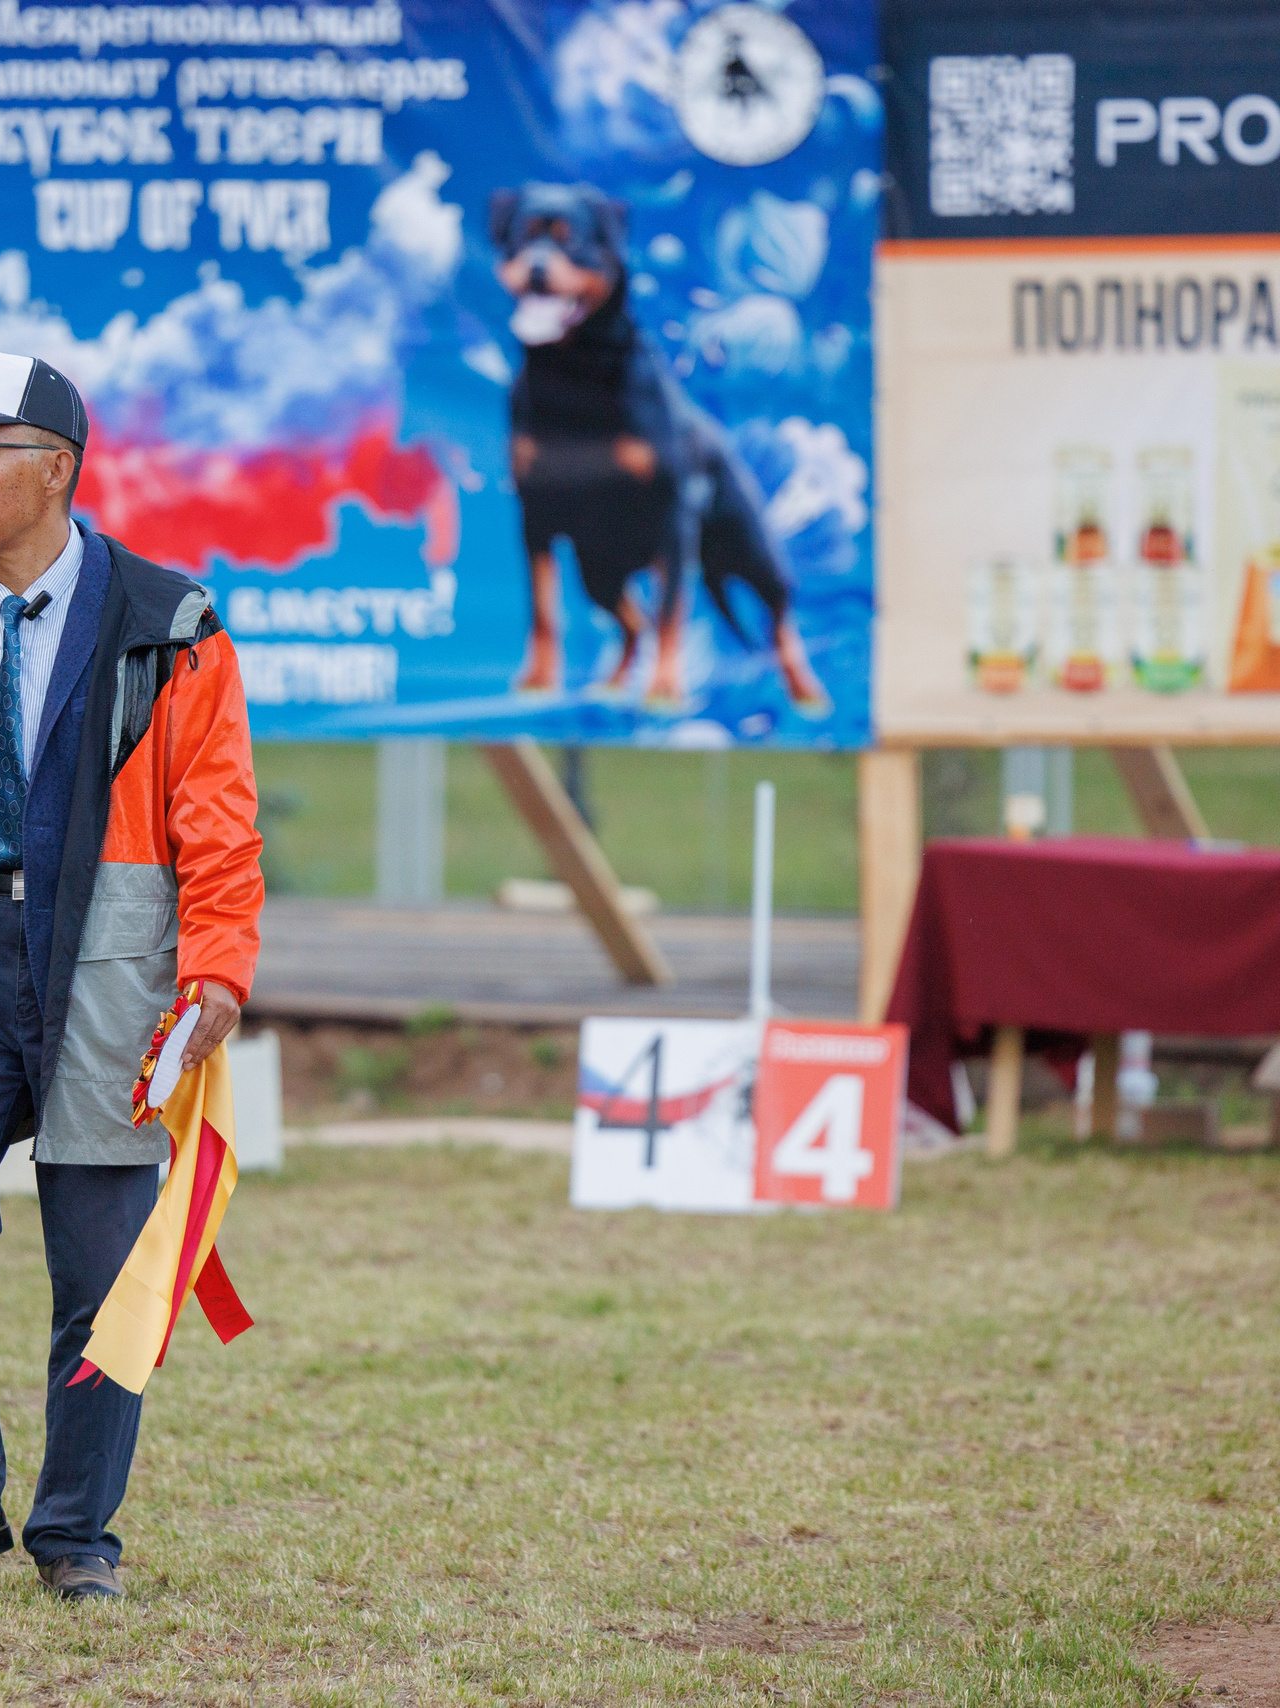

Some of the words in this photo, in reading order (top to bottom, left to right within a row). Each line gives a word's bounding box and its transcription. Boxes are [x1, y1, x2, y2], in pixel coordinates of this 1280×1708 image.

[176, 49, 469, 113] ротвейлеров
[182, 106, 384, 165] ТВЕРИ
[1095, 94, 1280, 167] PRO
[33, 178, 132, 252] CUP
[137, 178, 204, 252] OF
[207, 178, 331, 252] TVER
[1013, 277, 1279, 353] ПОЛНОРА
[596, 1032, 676, 1170] 4
[772, 1072, 876, 1203] 4
